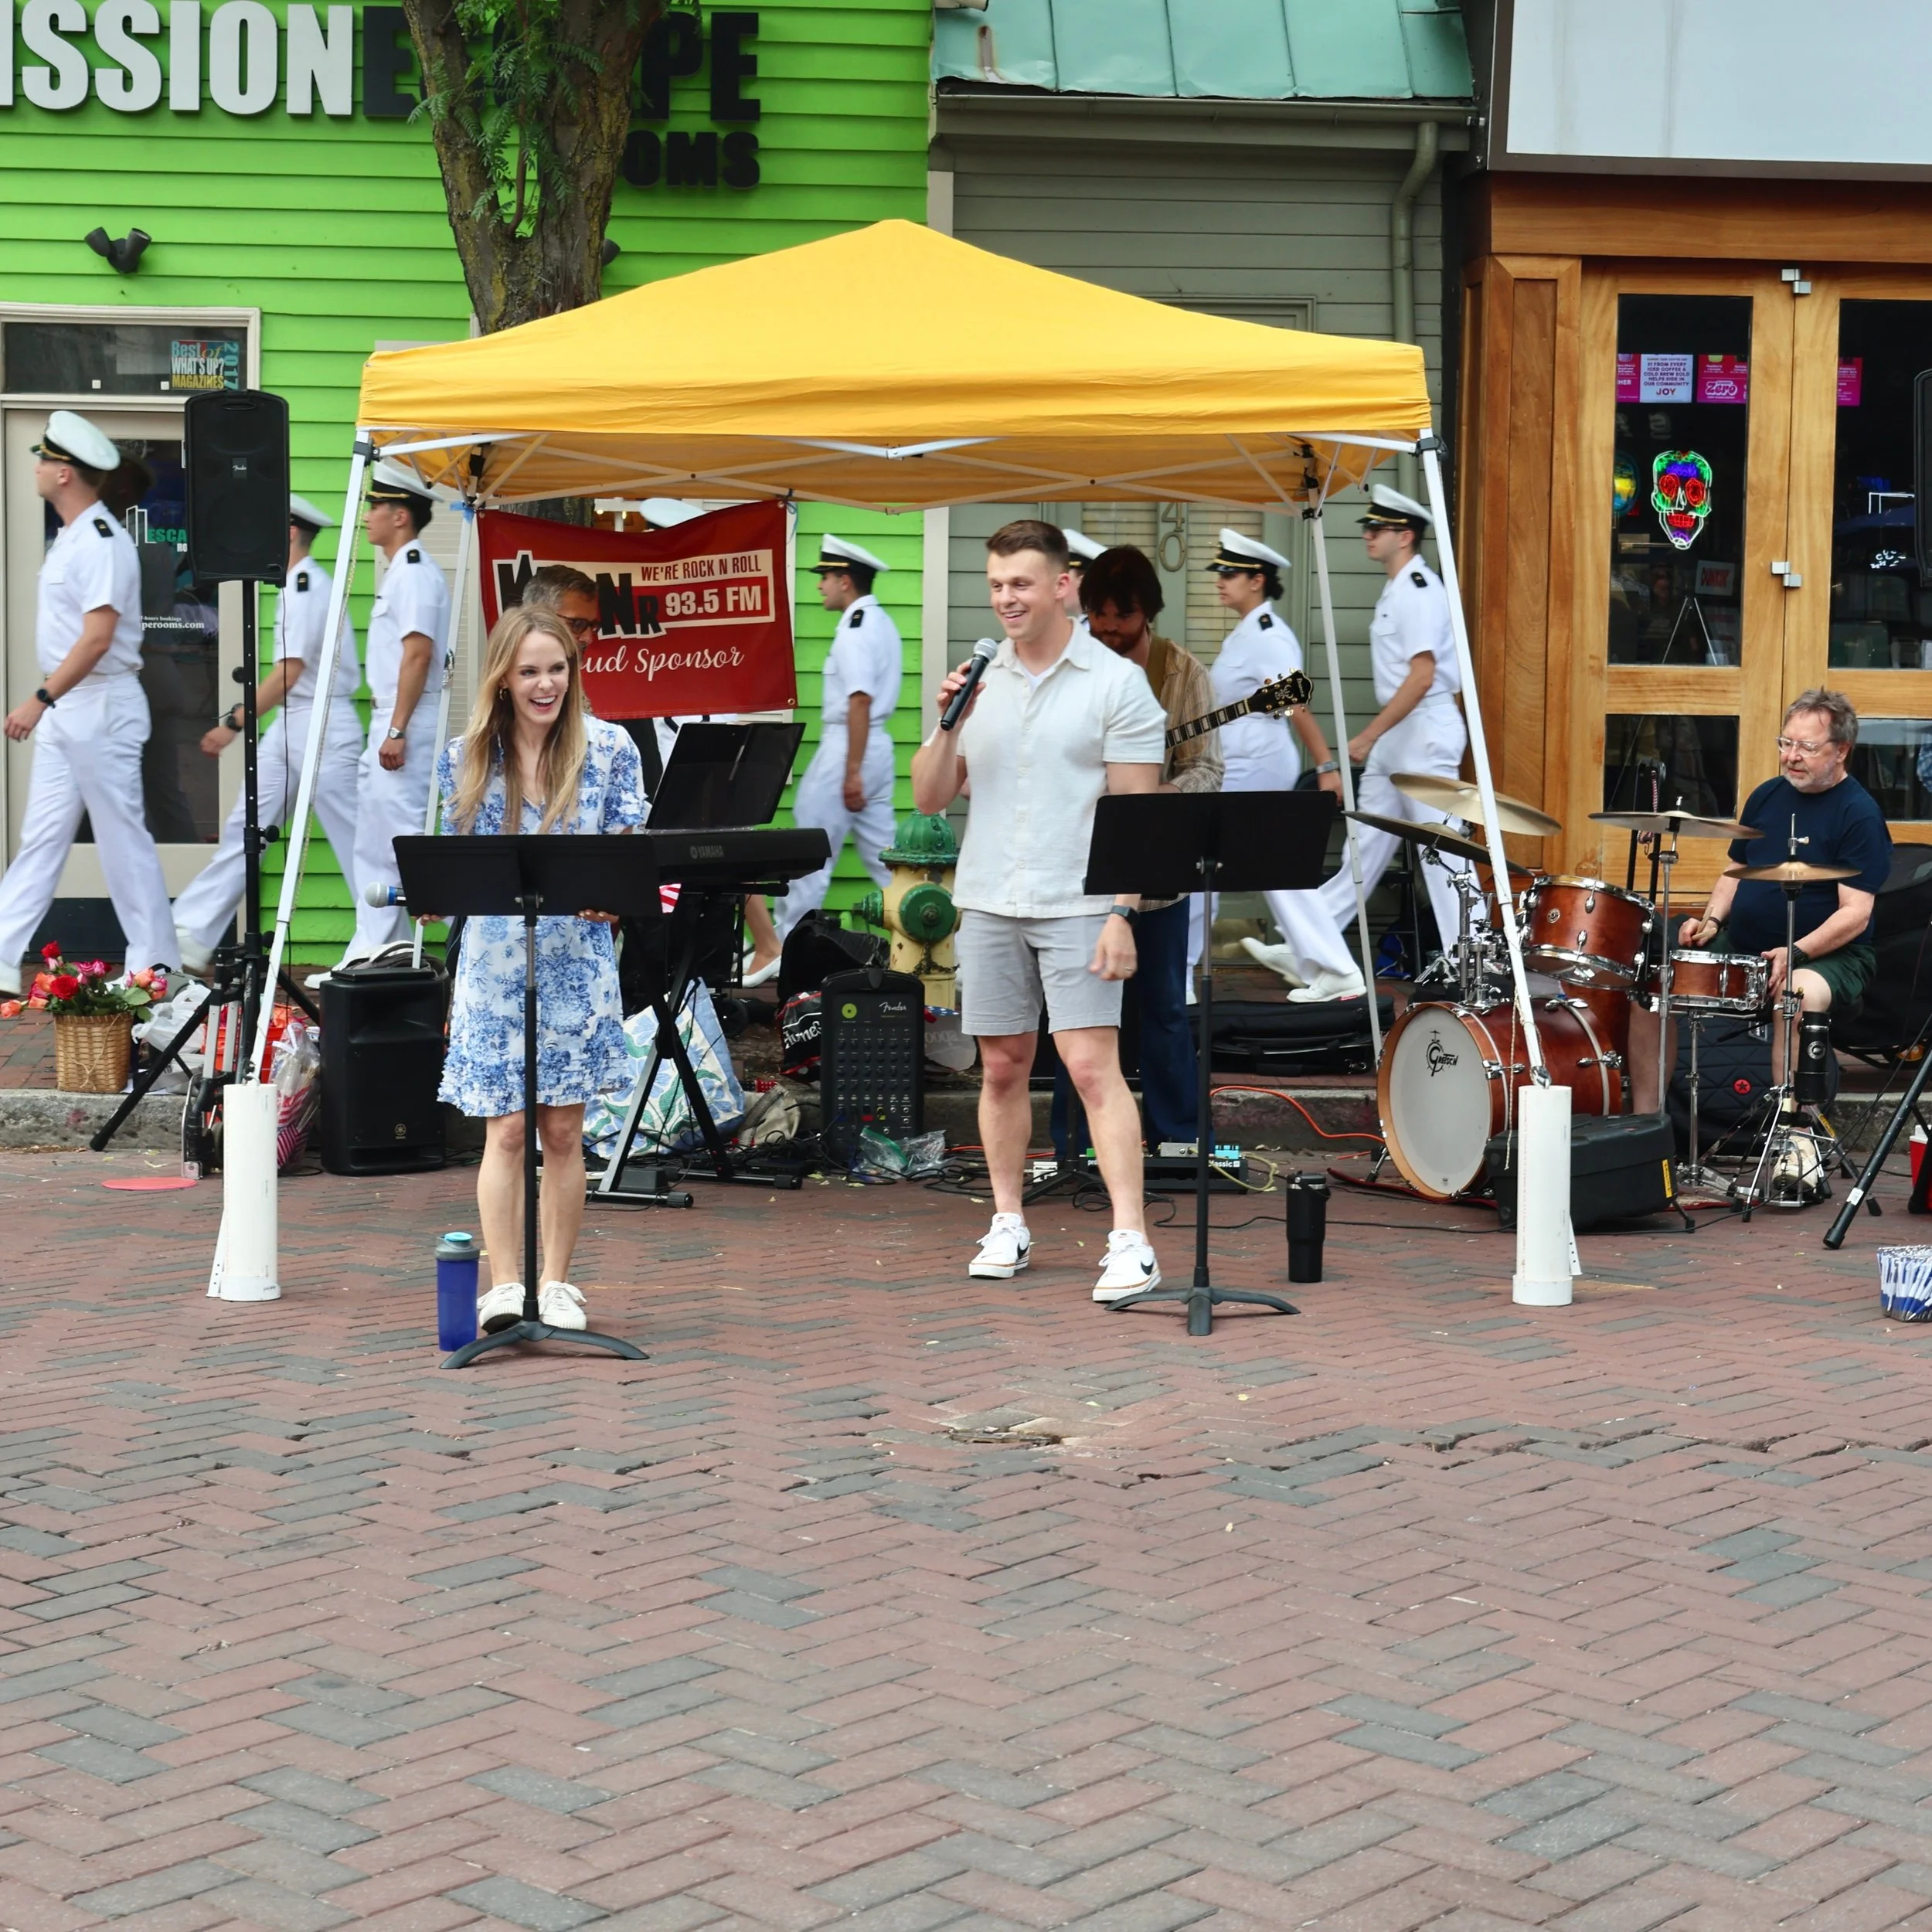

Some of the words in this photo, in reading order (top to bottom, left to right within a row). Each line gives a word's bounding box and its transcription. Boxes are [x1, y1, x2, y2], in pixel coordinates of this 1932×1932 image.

[623, 130, 760, 189] OMS
[172, 341, 201, 358] Best
[172, 357, 206, 376] WHAT'S
[206, 358, 224, 376] UP?
[224, 342, 239, 390] 2017
[172, 374, 225, 389] MAGAZINES
[1706, 381, 1737, 396] Zero
[148, 529, 187, 542] ESCA
[641, 563, 679, 581] WE'RE
[683, 559, 716, 579] ROCK
[719, 558, 728, 575] N
[732, 554, 761, 573] ROLL
[665, 588, 719, 617] 93.5
[726, 585, 762, 612] FM
[141, 621, 205, 631] perooms.com
[634, 646, 745, 682] Sponsor
[879, 1001, 907, 1013] Fender
